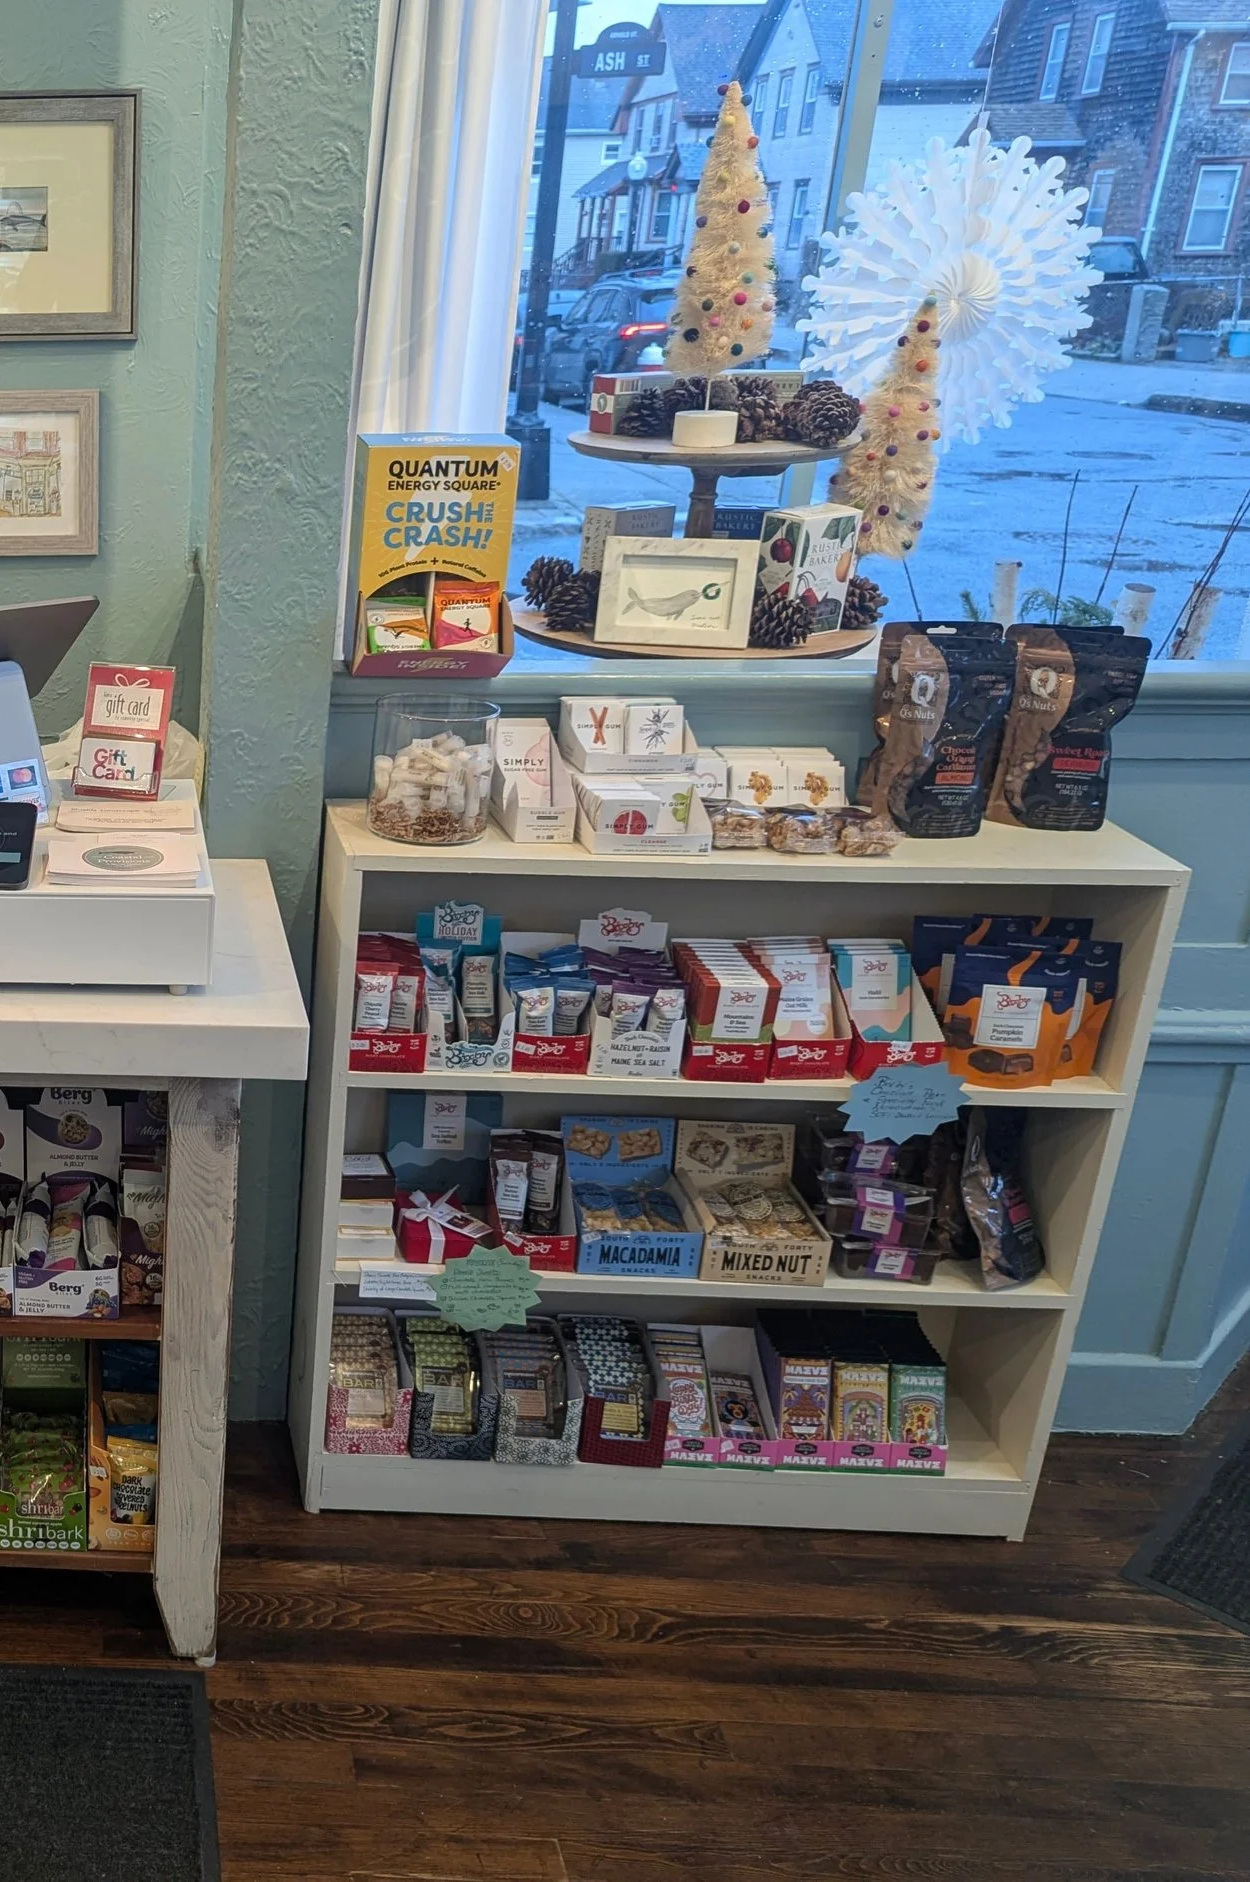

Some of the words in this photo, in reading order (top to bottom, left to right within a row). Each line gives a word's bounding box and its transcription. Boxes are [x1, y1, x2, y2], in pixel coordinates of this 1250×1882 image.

[594, 51, 626, 72] ASH
[637, 54, 650, 66] ST
[389, 460, 499, 479] QUANTUM
[388, 481, 440, 491] ENERGY
[385, 501, 484, 523] CRUSH
[485, 502, 494, 523] THE
[717, 513, 755, 522] RUSTIC
[716, 522, 755, 530] BAKERY
[384, 525, 493, 549] CRASH!
[440, 598, 491, 606] QUANTUM
[106, 693, 126, 718] gift
[127, 696, 150, 717] card
[1032, 699, 1056, 712] Nuts
[914, 709, 935, 720] Nuts
[94, 748, 128, 766] Gift
[503, 758, 544, 766] SIMPLY
[92, 763, 135, 781] Card
[438, 927, 478, 936] HOLIDAY
[992, 1028, 1024, 1036] Pumpkin
[598, 1245, 680, 1267] MACADAMIA
[721, 1250, 773, 1272] MIXED
[776, 1254, 812, 1275] NUT
[49, 1281, 81, 1295] Berg
[343, 1378, 375, 1389] BAR
[423, 1374, 464, 1386] BAR
[504, 1379, 536, 1388] BAR
[594, 1390, 628, 1402] BAR
